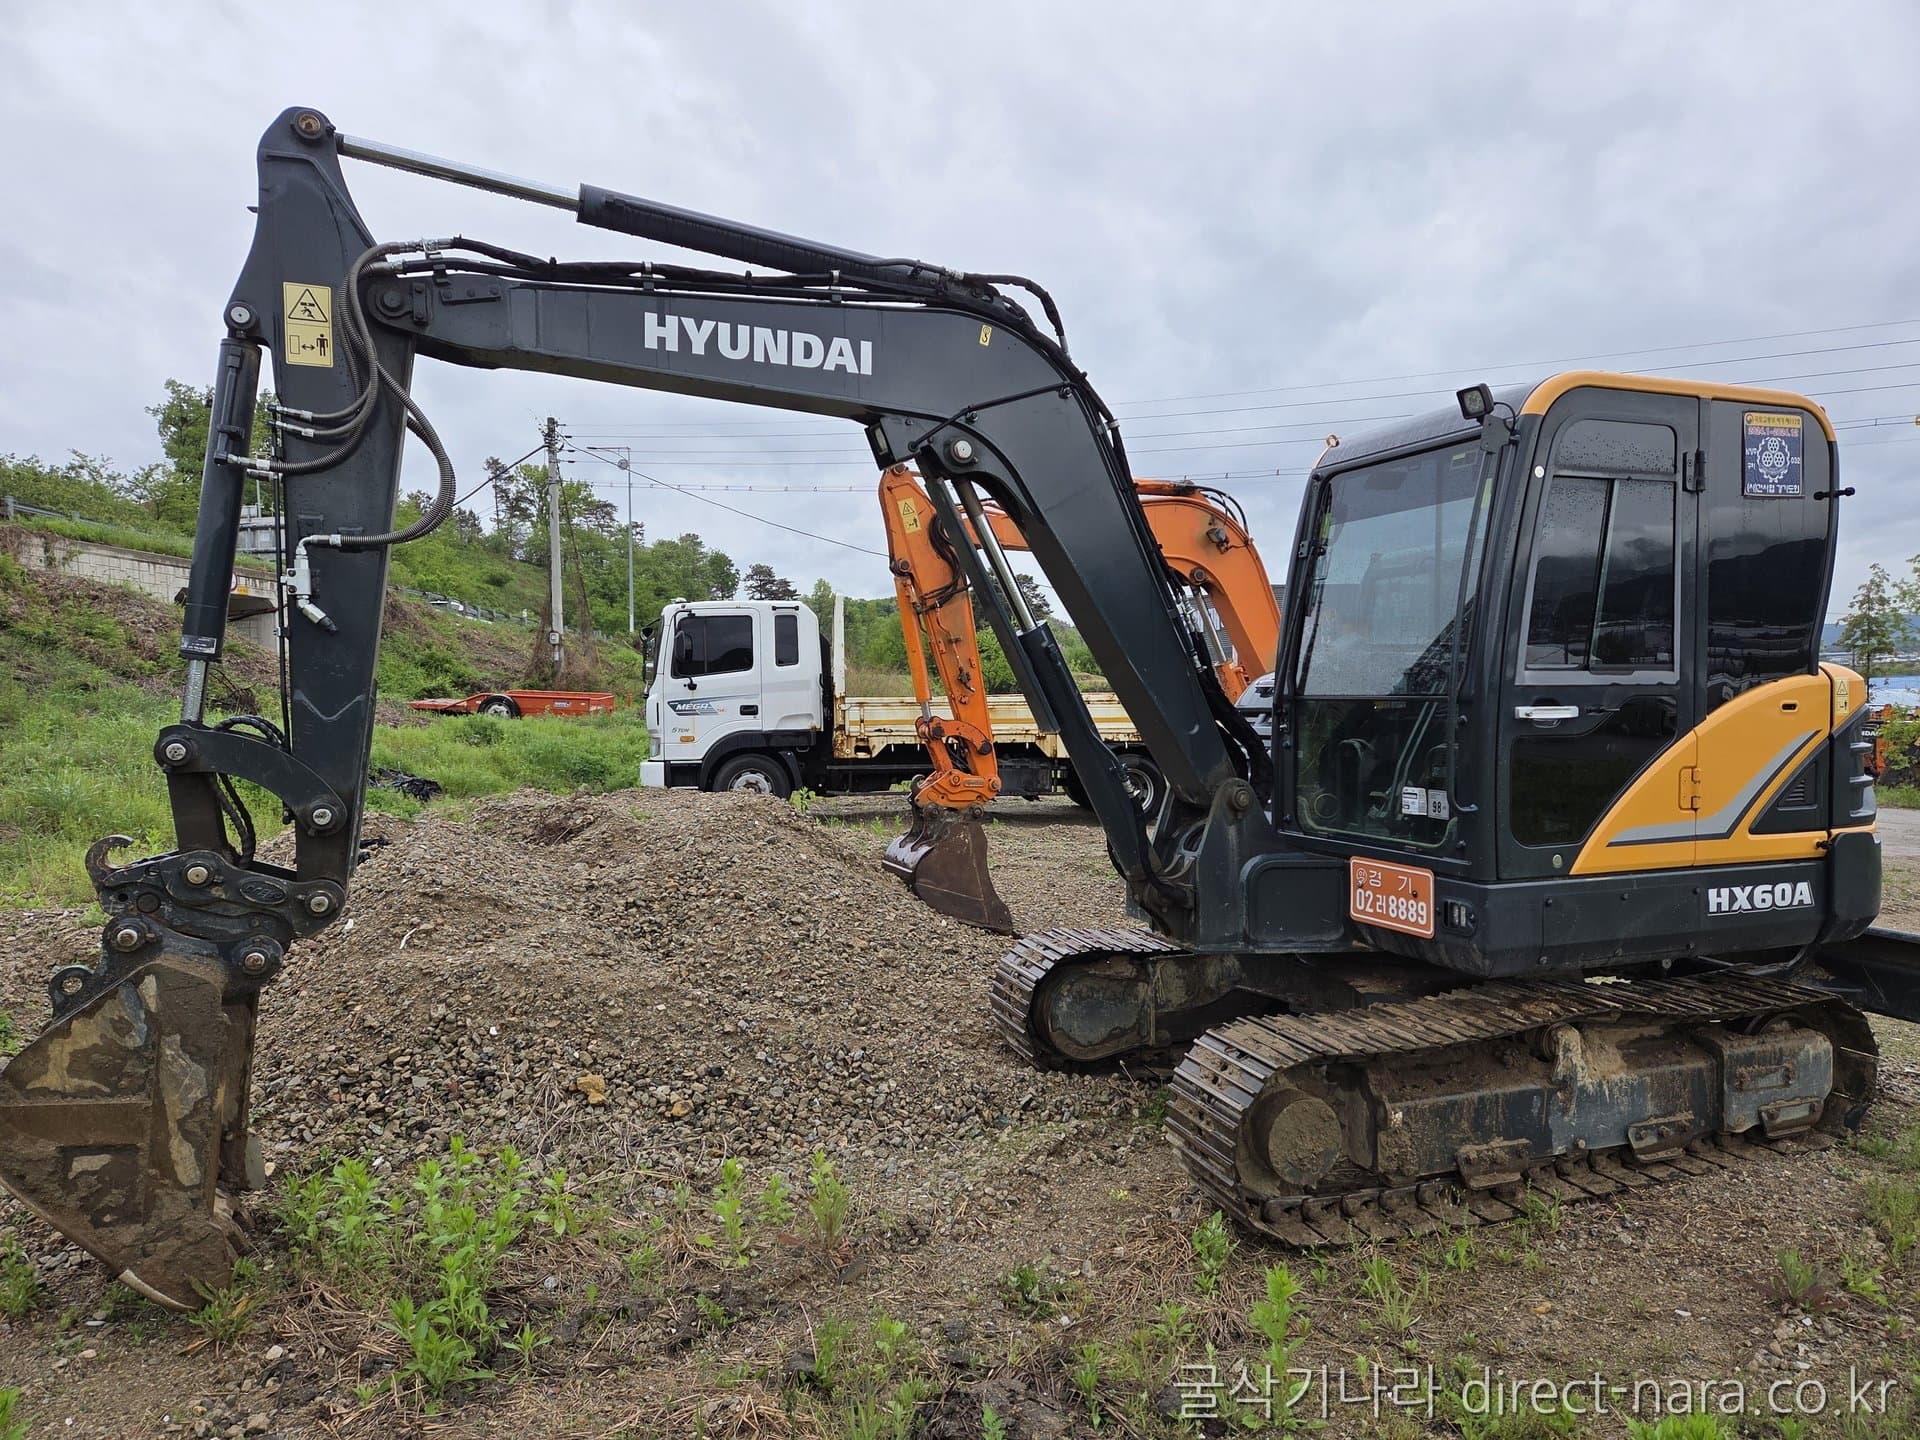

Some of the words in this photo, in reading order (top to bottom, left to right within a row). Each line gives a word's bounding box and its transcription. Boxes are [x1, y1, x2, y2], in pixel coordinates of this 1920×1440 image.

[644, 312, 872, 375] HYUNDAI
[675, 703, 711, 711] MEGA
[1432, 801, 1442, 813] 98
[1356, 888, 1427, 925] 02러8889
[1707, 881, 1814, 915] HX60A
